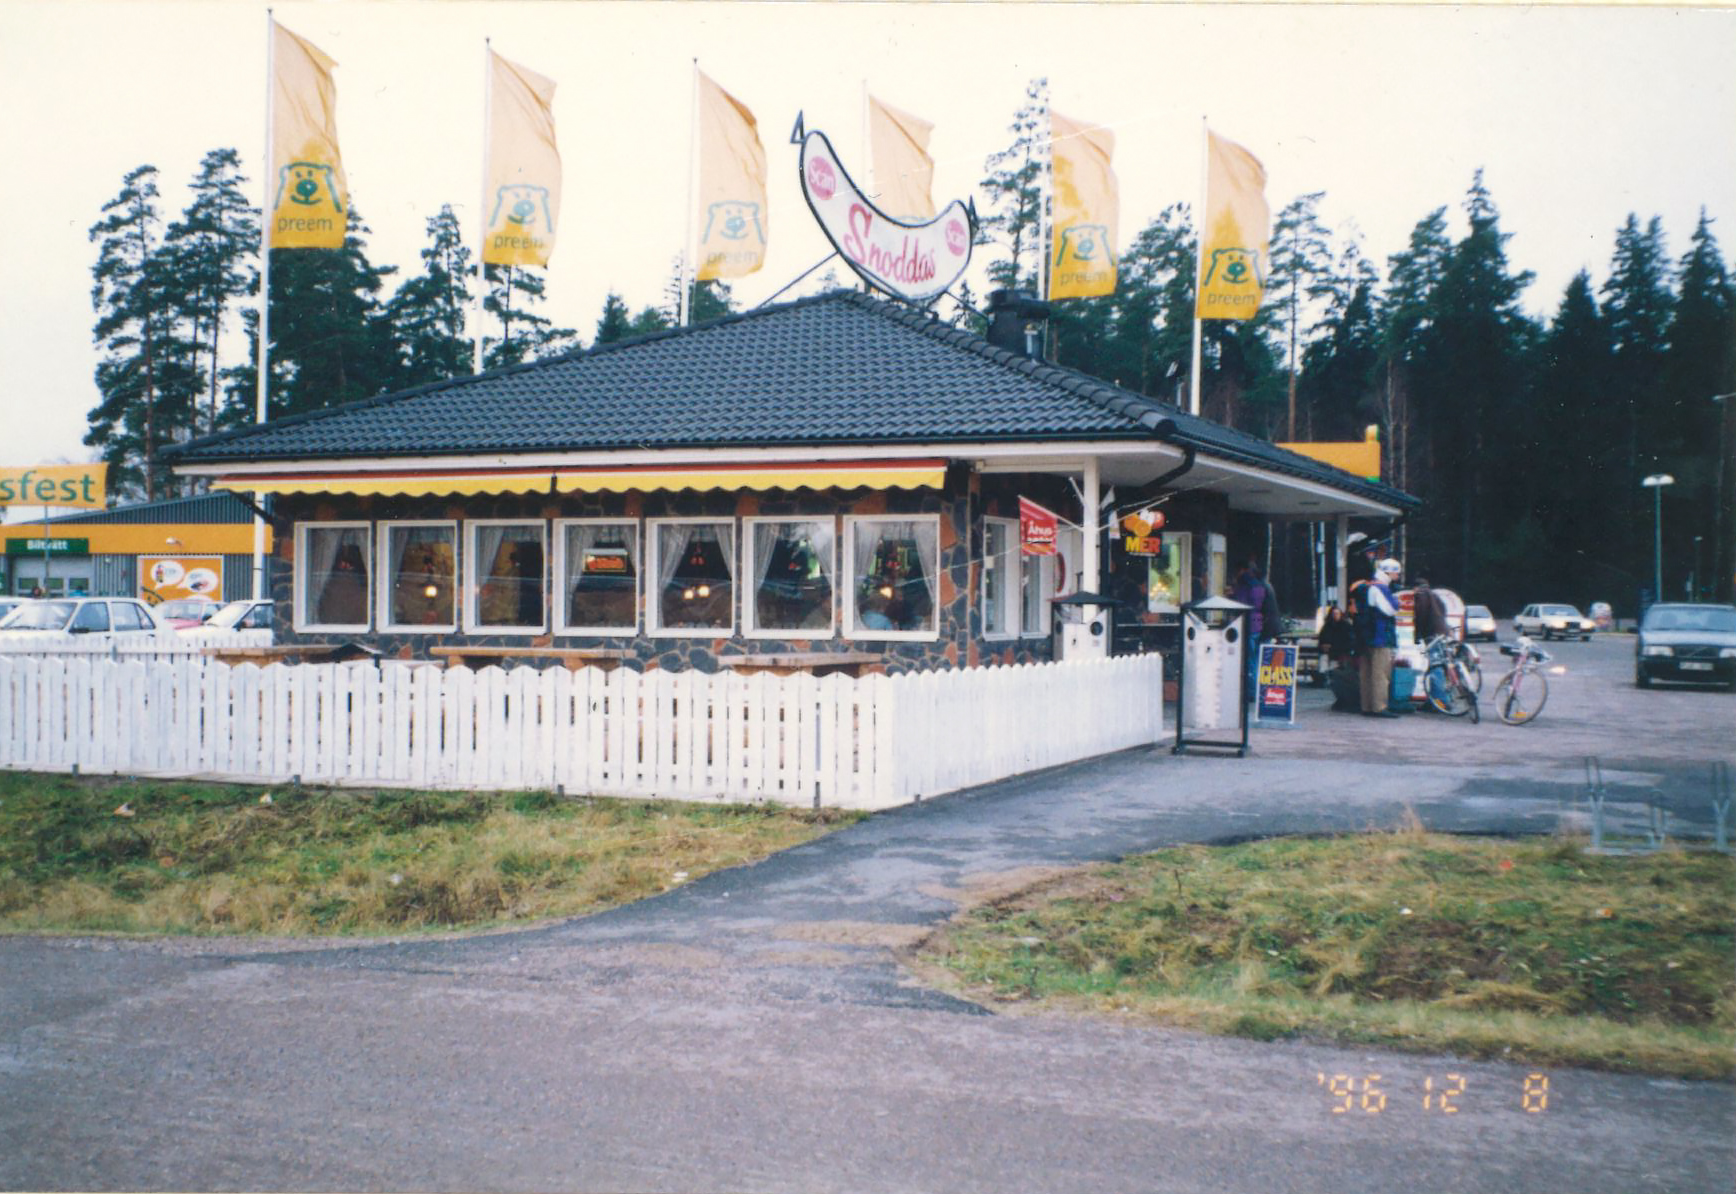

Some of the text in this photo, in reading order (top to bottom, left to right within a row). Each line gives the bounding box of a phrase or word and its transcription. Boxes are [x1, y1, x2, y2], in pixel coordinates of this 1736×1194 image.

[278, 217, 333, 233] preem
[1206, 293, 1256, 307] preem
[1125, 536, 1162, 553] MER
